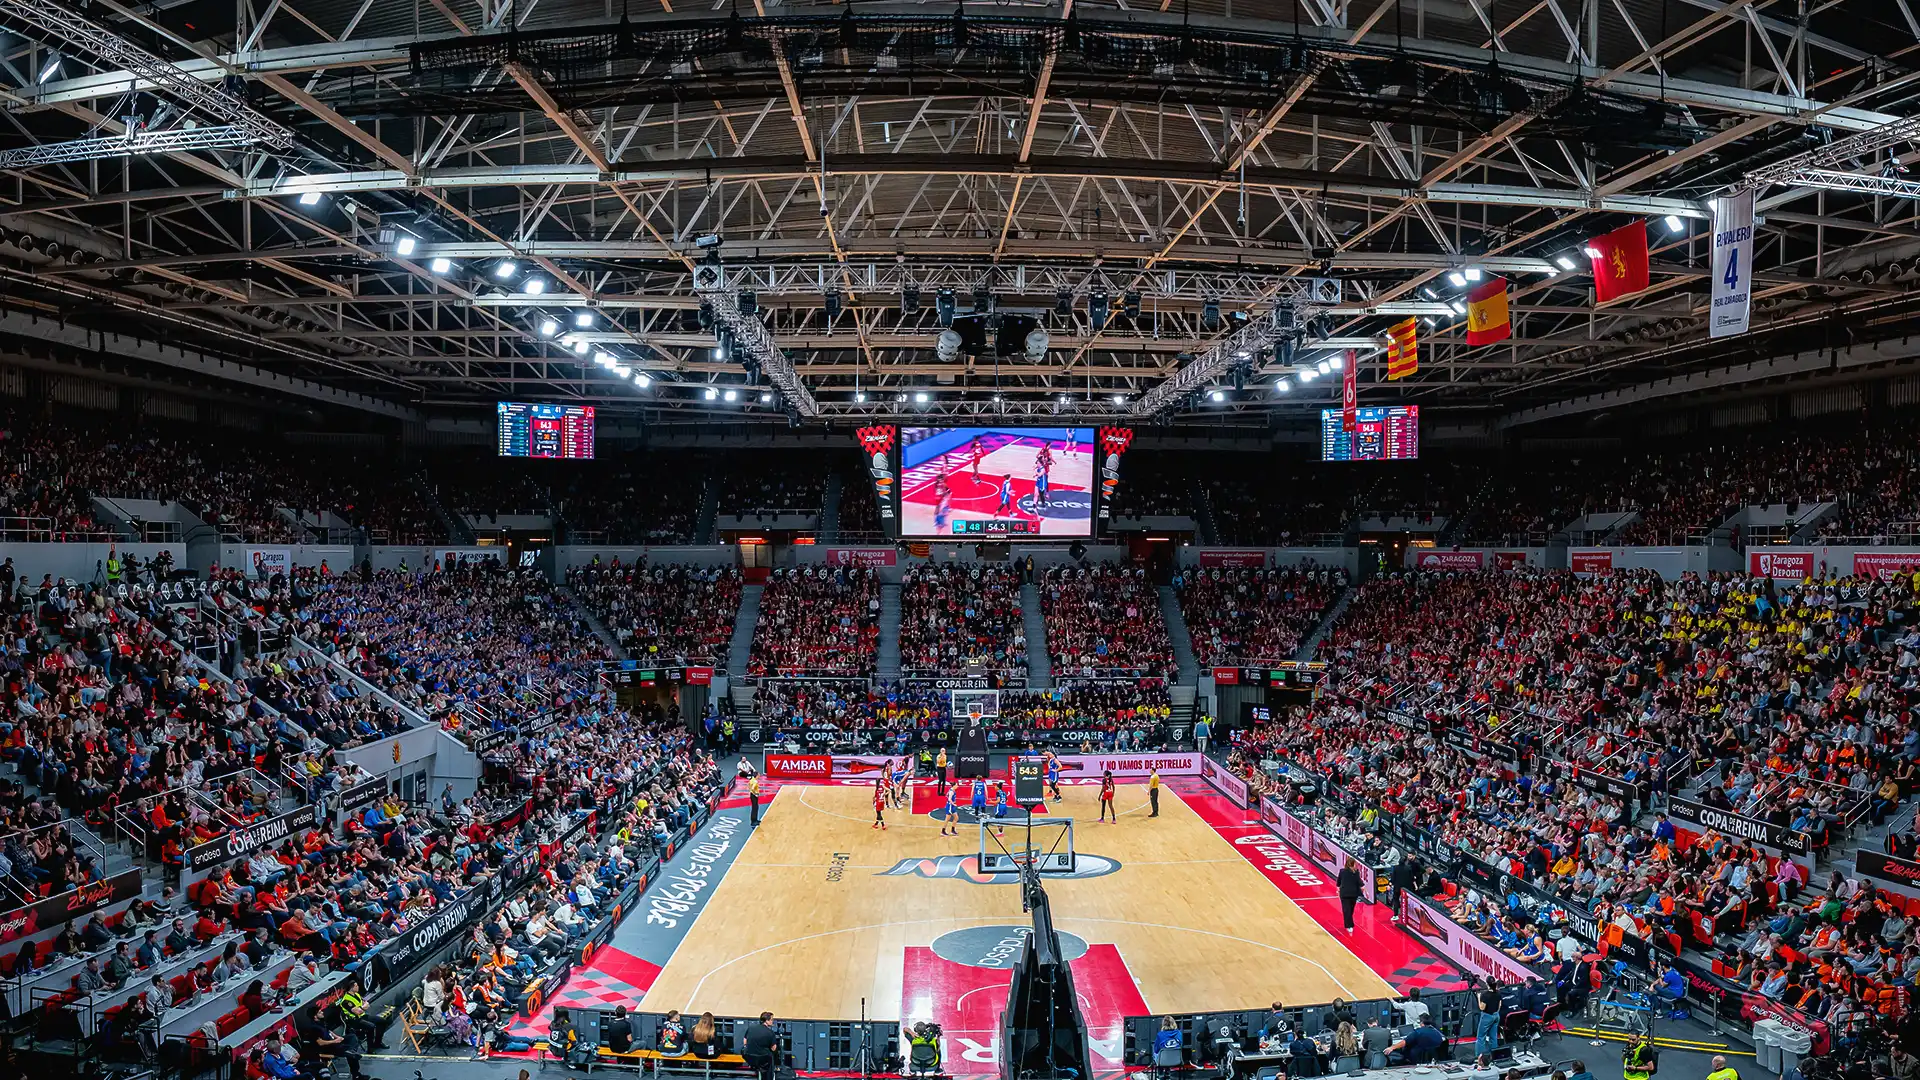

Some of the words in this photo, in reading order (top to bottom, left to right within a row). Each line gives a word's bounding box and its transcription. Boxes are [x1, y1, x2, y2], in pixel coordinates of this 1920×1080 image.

[1724, 248, 1739, 290] 4
[1725, 293, 1748, 305] ZARAGOZA
[1346, 382, 1354, 403] 6
[988, 523, 1006, 531] 54.3
[263, 552, 284, 563] Zaragoza
[852, 551, 885, 559] Zaragoza
[1442, 555, 1476, 563] ZARAGOZA
[1772, 555, 1804, 569] Zaragoza
[936, 680, 961, 688] COPA
[968, 680, 988, 688] REIN
[806, 732, 833, 741] COPA
[1062, 731, 1090, 741] COPA
[781, 760, 826, 771] AMBAR
[1099, 761, 1104, 770] Y
[1106, 761, 1116, 770] NO
[1118, 760, 1142, 770] VAMOS
[1144, 760, 1153, 770] DE
[1155, 759, 1192, 769] ESTRELLAS
[1019, 767, 1038, 775] 54.3
[1671, 804, 1694, 817] endesa
[1700, 809, 1728, 831] COPA
[1728, 817, 1736, 826] DE
[1735, 818, 1768, 843] REINA
[1728, 825, 1735, 833] LA
[194, 848, 222, 865] endesa
[261, 818, 289, 840] REINA
[292, 812, 313, 827] endesa
[1254, 844, 1324, 887] Zaragoza
[392, 944, 411, 965] endesa
[413, 922, 440, 952] COPA
[445, 903, 469, 931] REINA
[1458, 938, 1464, 955] Y
[1464, 941, 1472, 962] NO
[1472, 946, 1494, 976] VAMOS
[1493, 961, 1502, 981] DE
[1750, 1005, 1769, 1016] DONDE
[1768, 1010, 1783, 1024] TODO
[1791, 1021, 1819, 1039] POSIBLE
